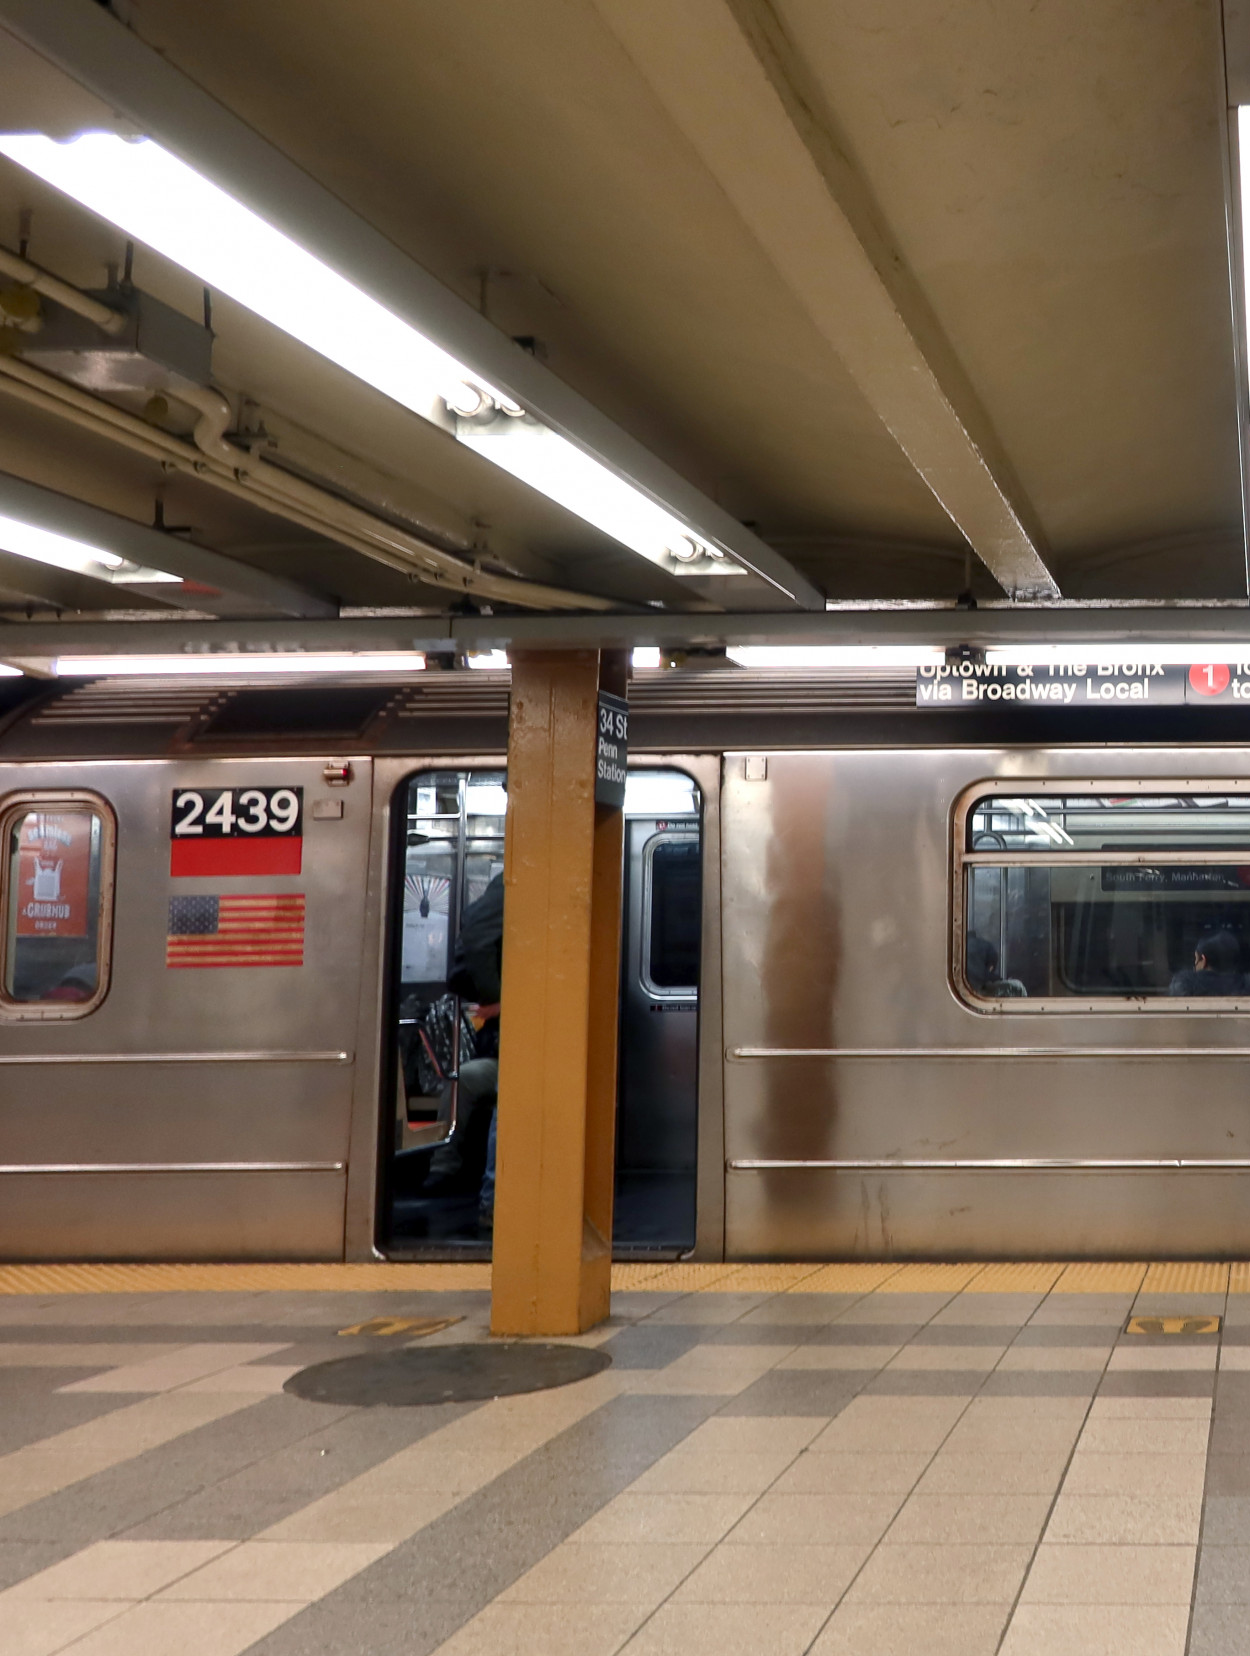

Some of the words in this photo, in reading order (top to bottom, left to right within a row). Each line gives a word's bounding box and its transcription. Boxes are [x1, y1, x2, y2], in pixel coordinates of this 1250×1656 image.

[919, 661, 1007, 680] Uptown
[1202, 664, 1215, 688] 1
[919, 679, 952, 700] via
[961, 678, 1077, 703] Broadway
[1086, 678, 1149, 700] Local
[599, 708, 614, 736] 34
[615, 714, 628, 741] St
[598, 736, 618, 759] Penn
[597, 759, 626, 784] Station
[174, 788, 299, 835] 2439
[1106, 871, 1135, 882] South
[27, 902, 71, 919] GRUBHUB
